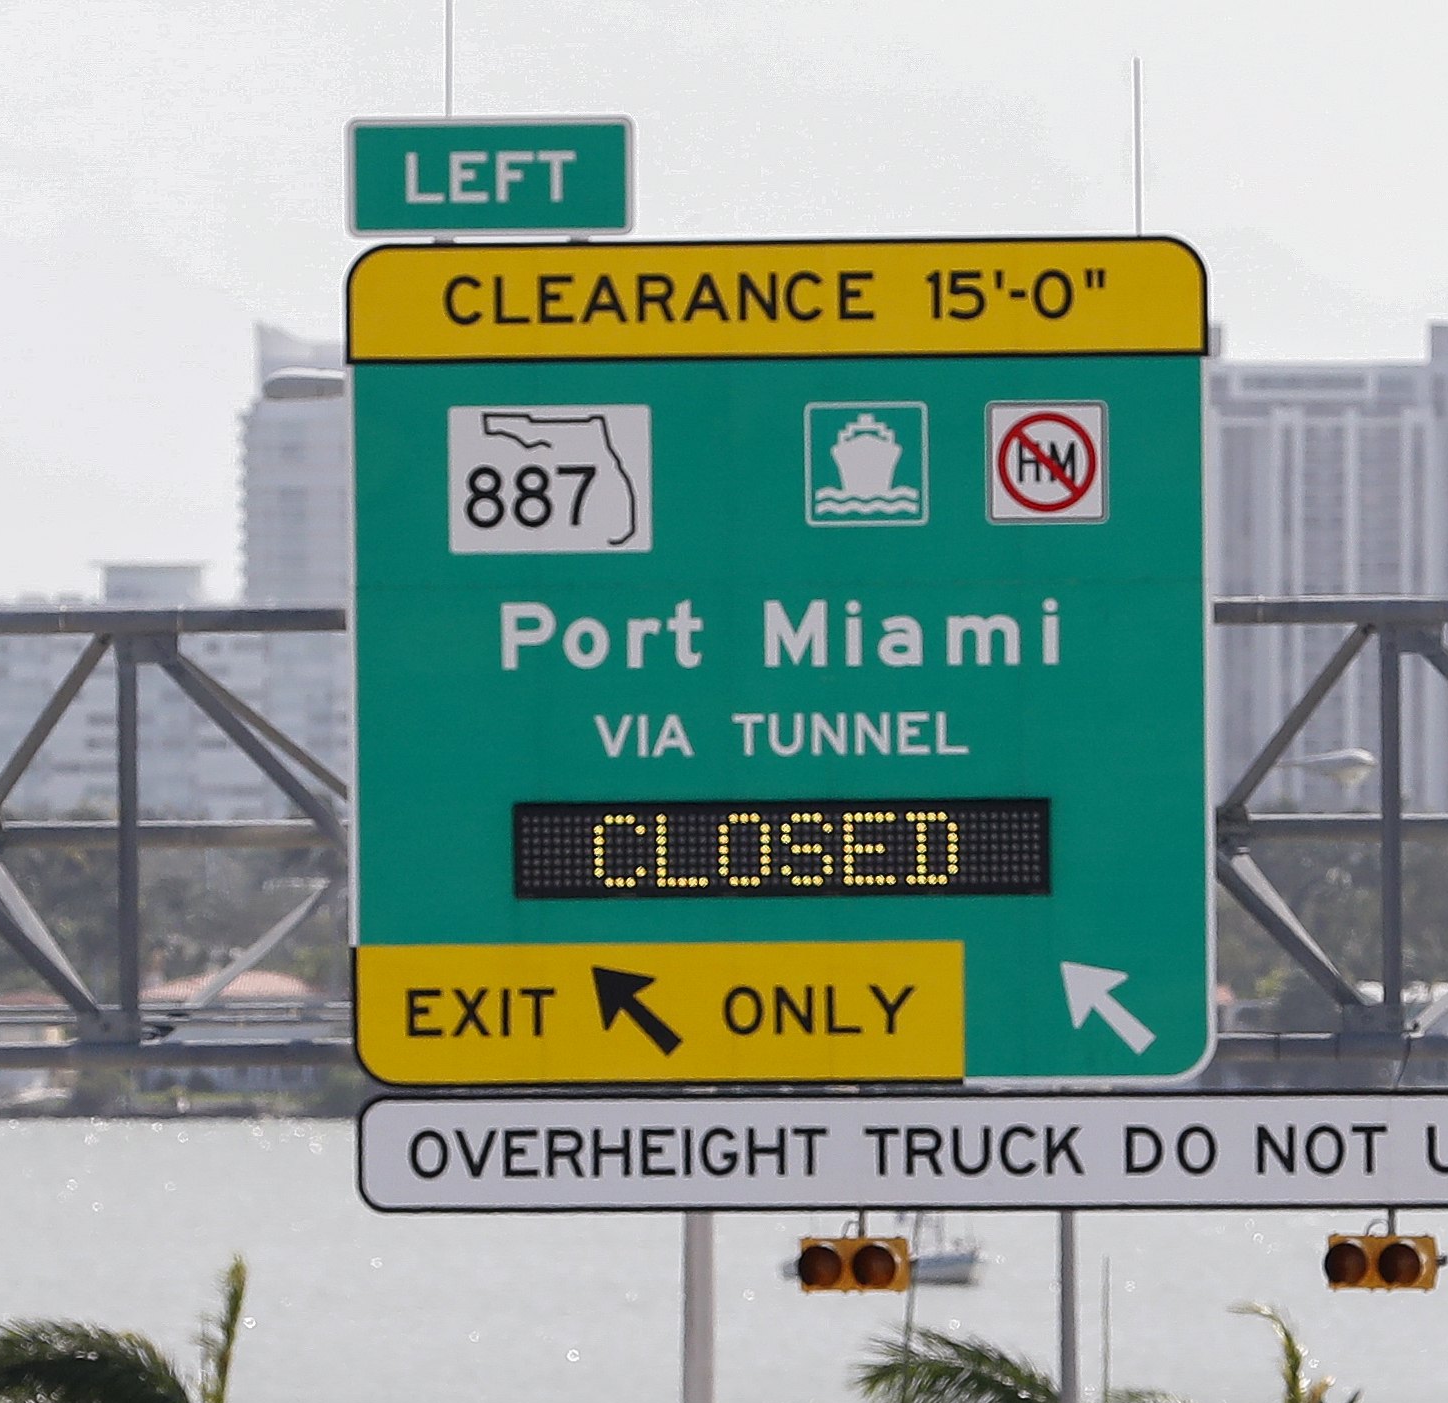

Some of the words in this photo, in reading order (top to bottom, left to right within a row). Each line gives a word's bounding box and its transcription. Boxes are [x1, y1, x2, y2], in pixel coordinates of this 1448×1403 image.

[405, 151, 577, 204] LEFT
[444, 271, 876, 326] CLEARANCE
[926, 269, 1106, 320] 15'-0"
[1018, 440, 1075, 482] HM
[465, 465, 597, 529] 887
[502, 600, 703, 669] Port
[765, 599, 1058, 667] Miami
[596, 715, 693, 757] VIA
[733, 712, 969, 756] TUNNEL
[593, 811, 959, 888] CLOSED
[406, 987, 556, 1038] EXIT
[723, 985, 915, 1036] ONLY
[409, 1127, 828, 1180] OVERHEIGHT
[864, 1125, 1085, 1177] TRUCK
[1125, 1125, 1218, 1175] DO
[1256, 1125, 1389, 1175] NOT
